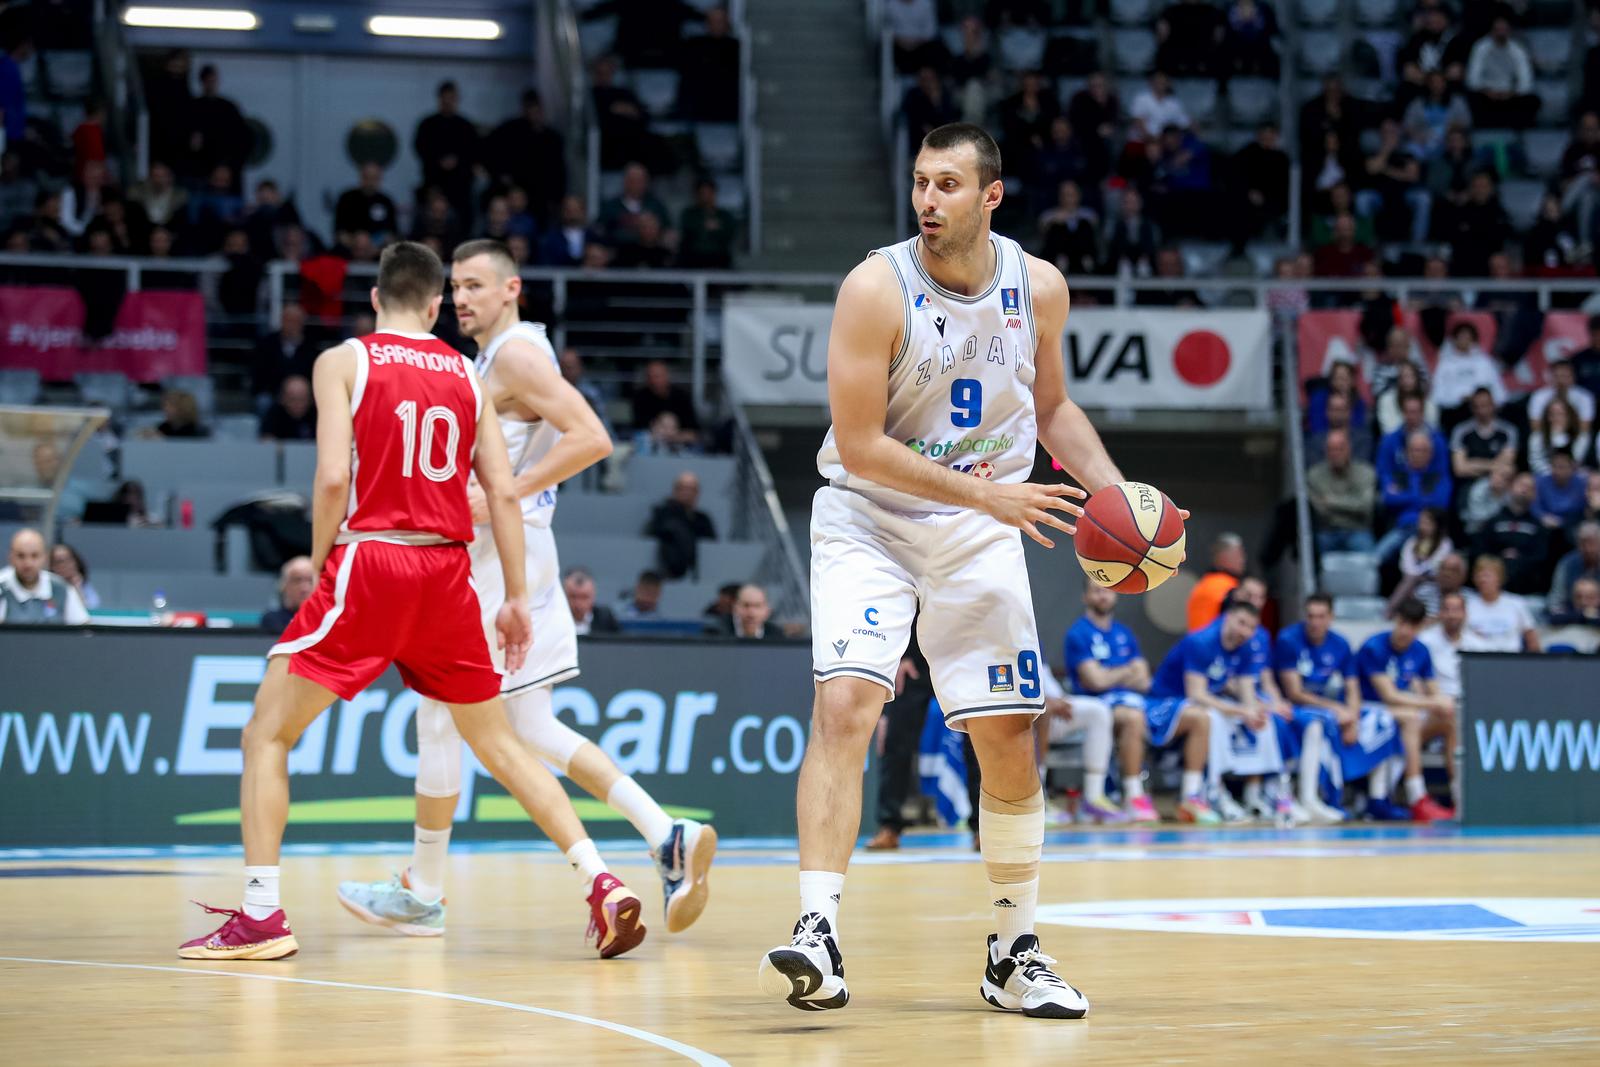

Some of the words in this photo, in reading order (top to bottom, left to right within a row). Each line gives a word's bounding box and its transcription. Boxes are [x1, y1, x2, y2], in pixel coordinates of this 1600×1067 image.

[950, 378, 983, 428] 9
[394, 399, 461, 483] 10
[852, 628, 887, 642] cromaris
[1017, 650, 1041, 698] 9
